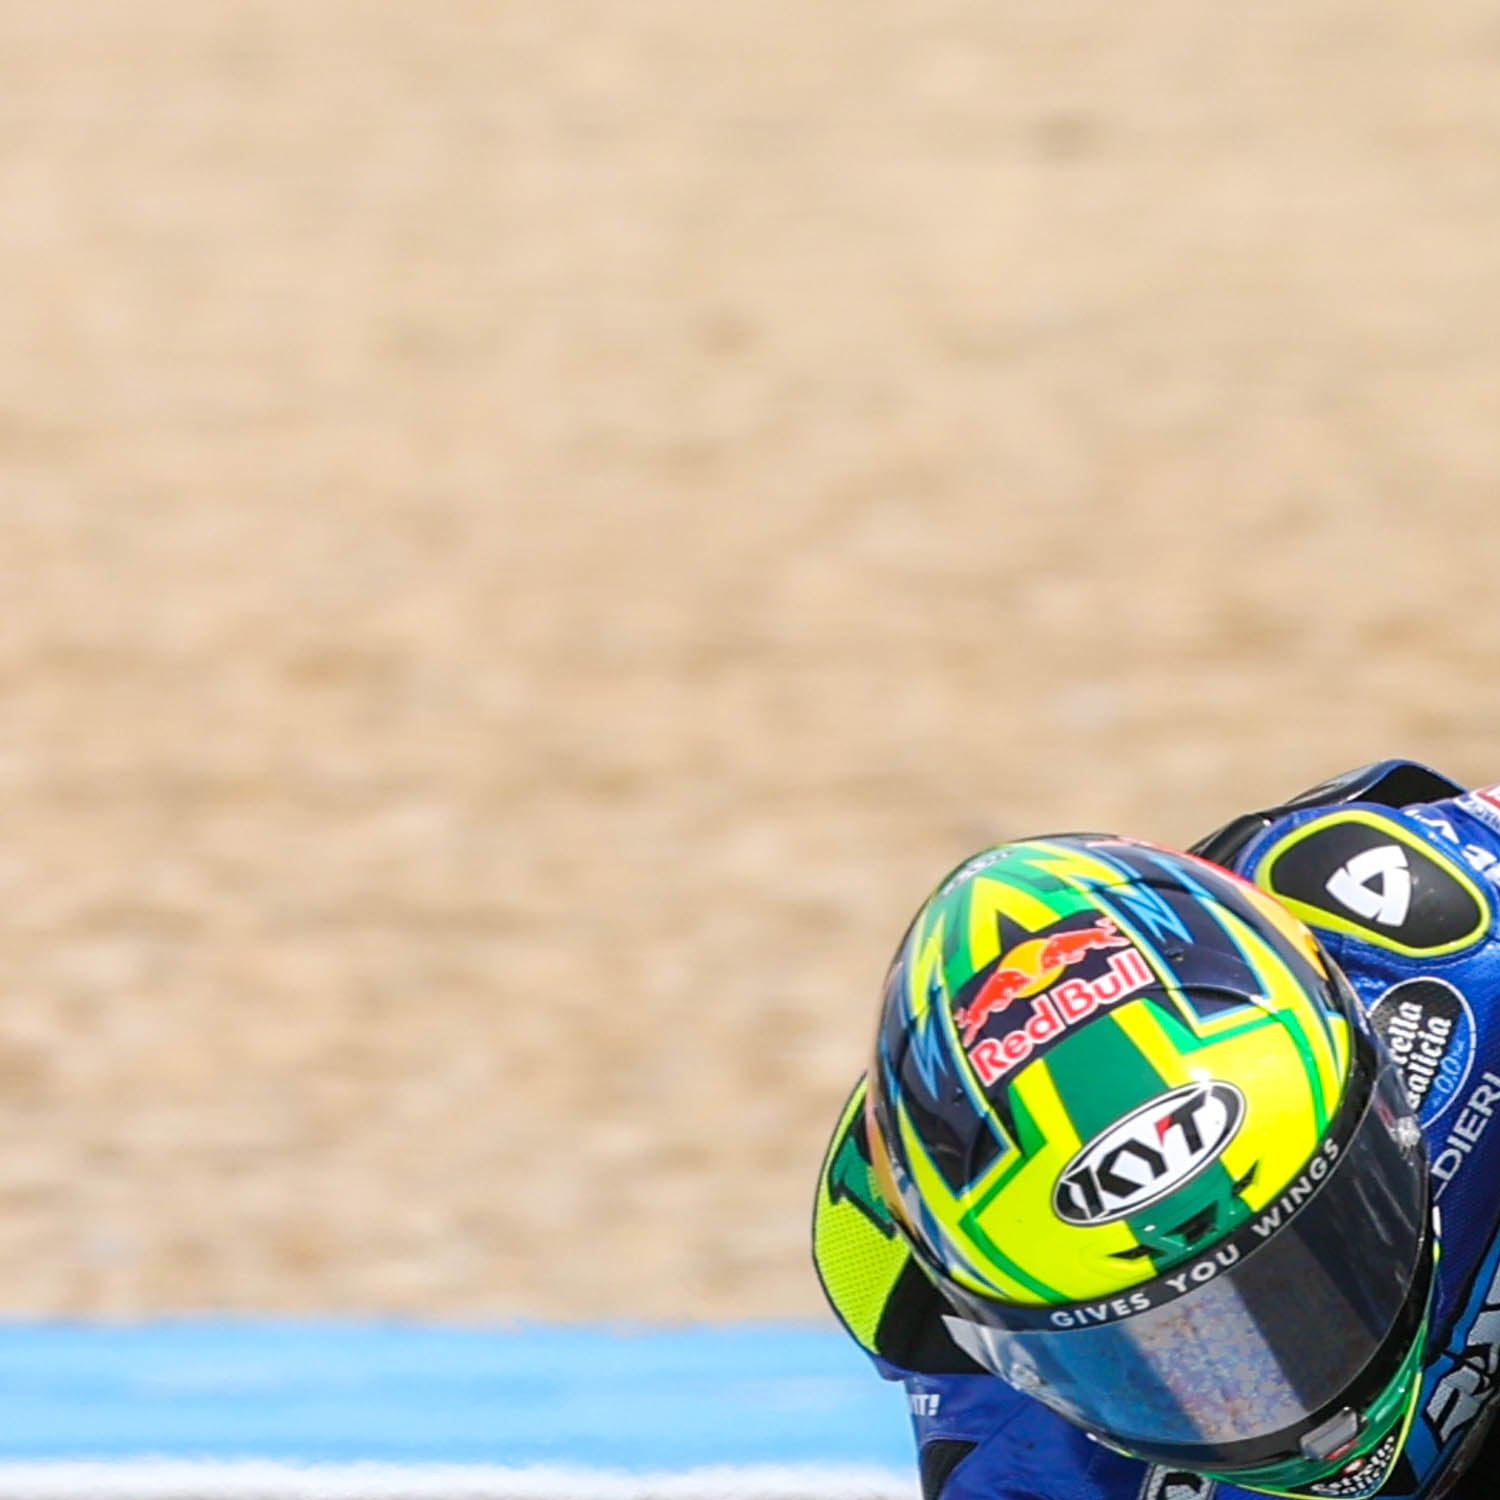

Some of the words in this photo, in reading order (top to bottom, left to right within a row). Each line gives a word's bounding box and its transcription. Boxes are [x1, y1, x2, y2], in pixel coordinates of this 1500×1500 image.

[968, 994, 1067, 1088] Red
[1049, 947, 1156, 1025] Bull
[1064, 1090, 1210, 1219] KYT
[1050, 1292, 1151, 1329] GIVES
[1165, 1243, 1241, 1295] YOU
[1251, 1137, 1341, 1238] WINGS
